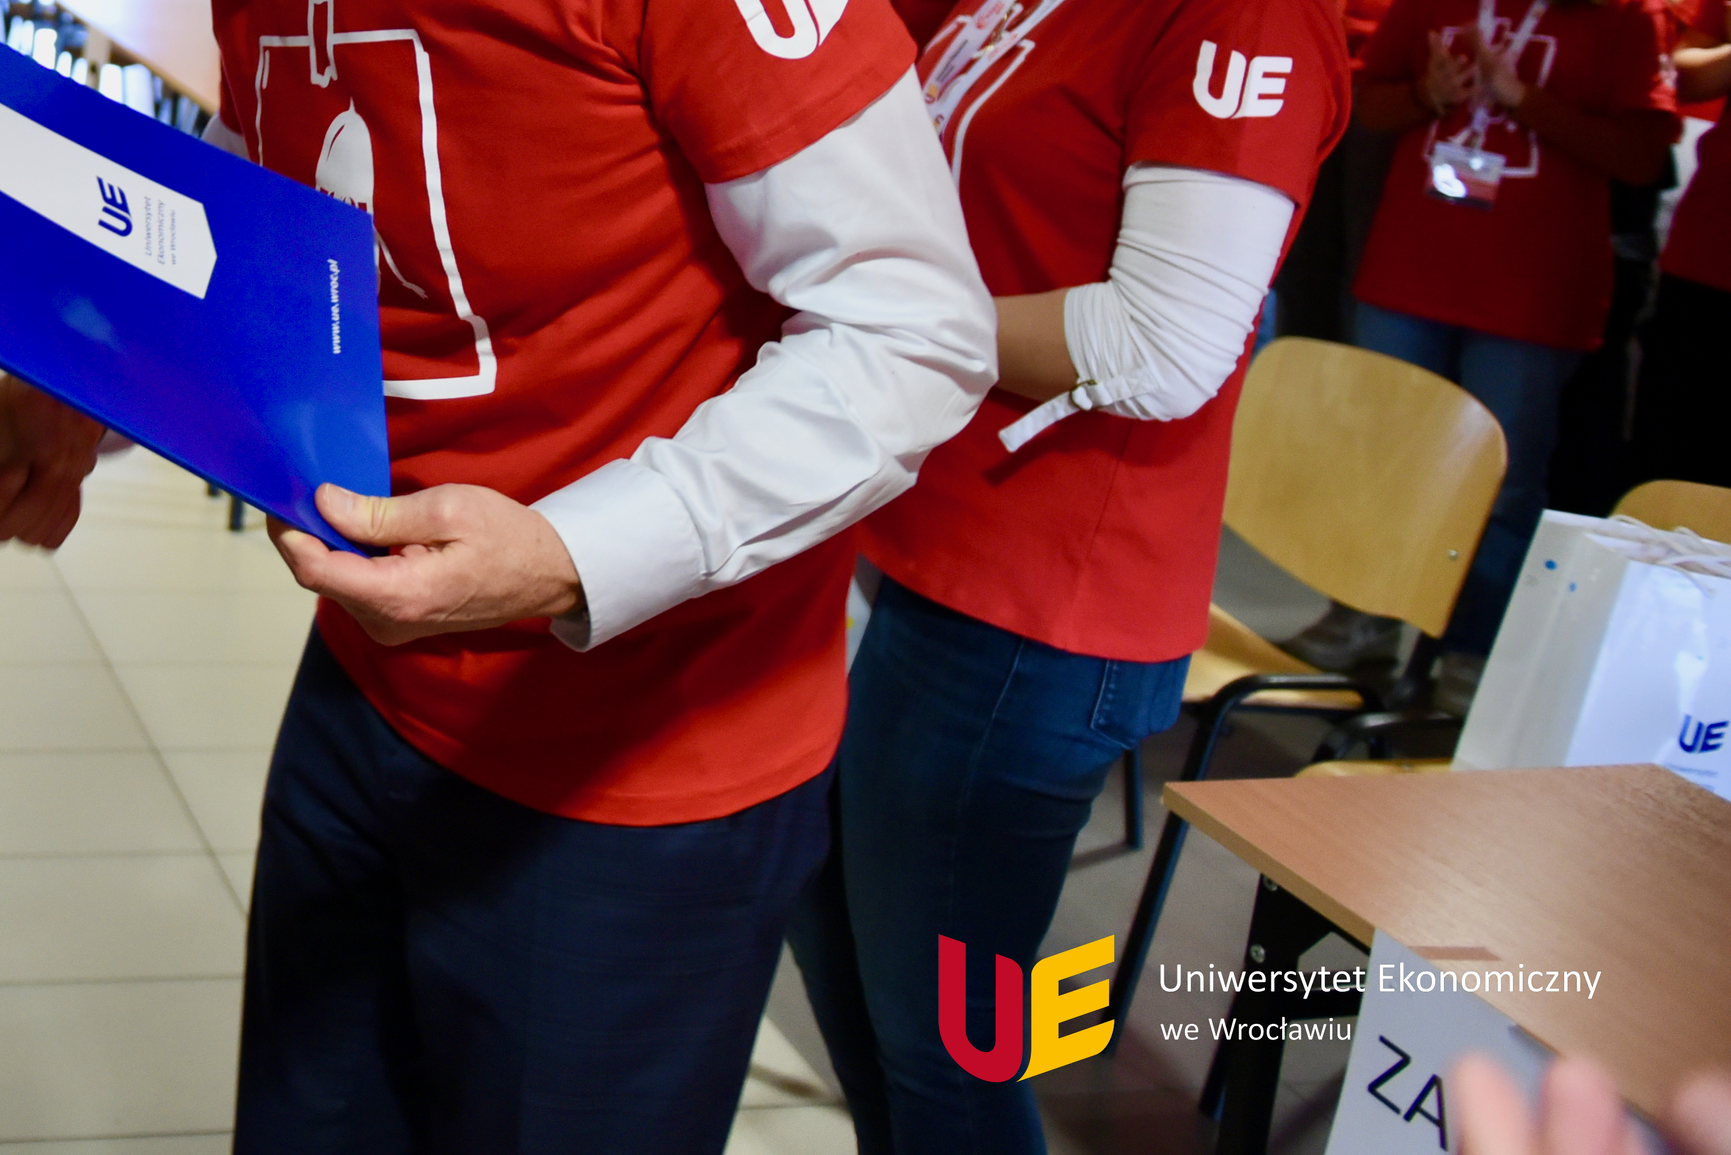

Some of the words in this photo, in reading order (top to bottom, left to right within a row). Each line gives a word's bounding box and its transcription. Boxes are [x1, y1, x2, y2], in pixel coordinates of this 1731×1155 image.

[1193, 41, 1293, 119] UE
[96, 176, 133, 237] UE
[1678, 713, 1729, 755] UE
